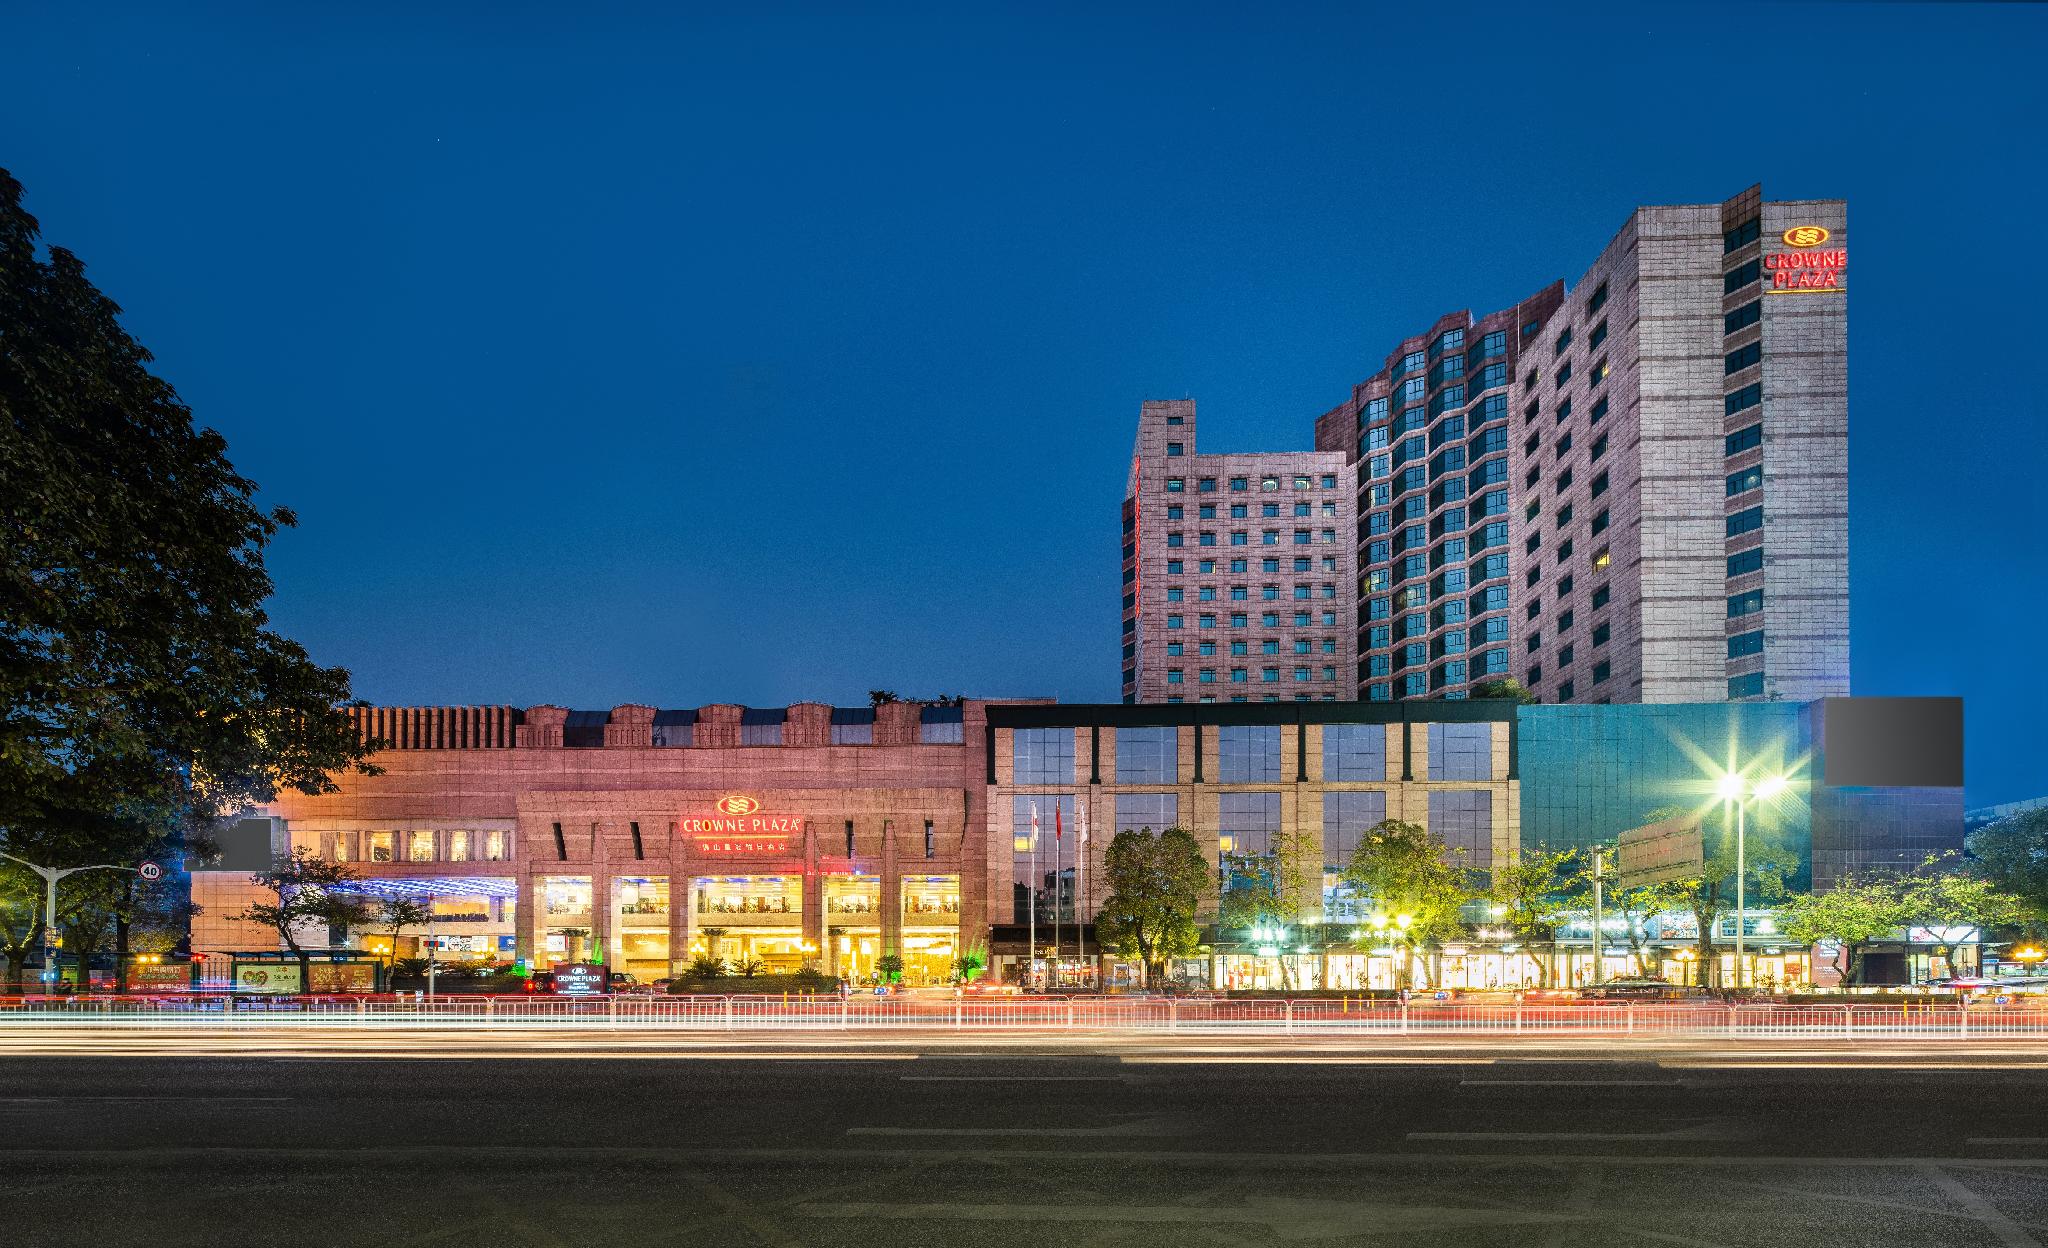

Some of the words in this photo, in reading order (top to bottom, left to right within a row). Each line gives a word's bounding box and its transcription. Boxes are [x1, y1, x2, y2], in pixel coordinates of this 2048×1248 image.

[1765, 250, 1847, 269] CROWNE
[1774, 270, 1838, 288] PLAZA
[683, 819, 746, 832] CROWNE
[753, 819, 799, 832] PLAZA
[144, 867, 157, 875] 40
